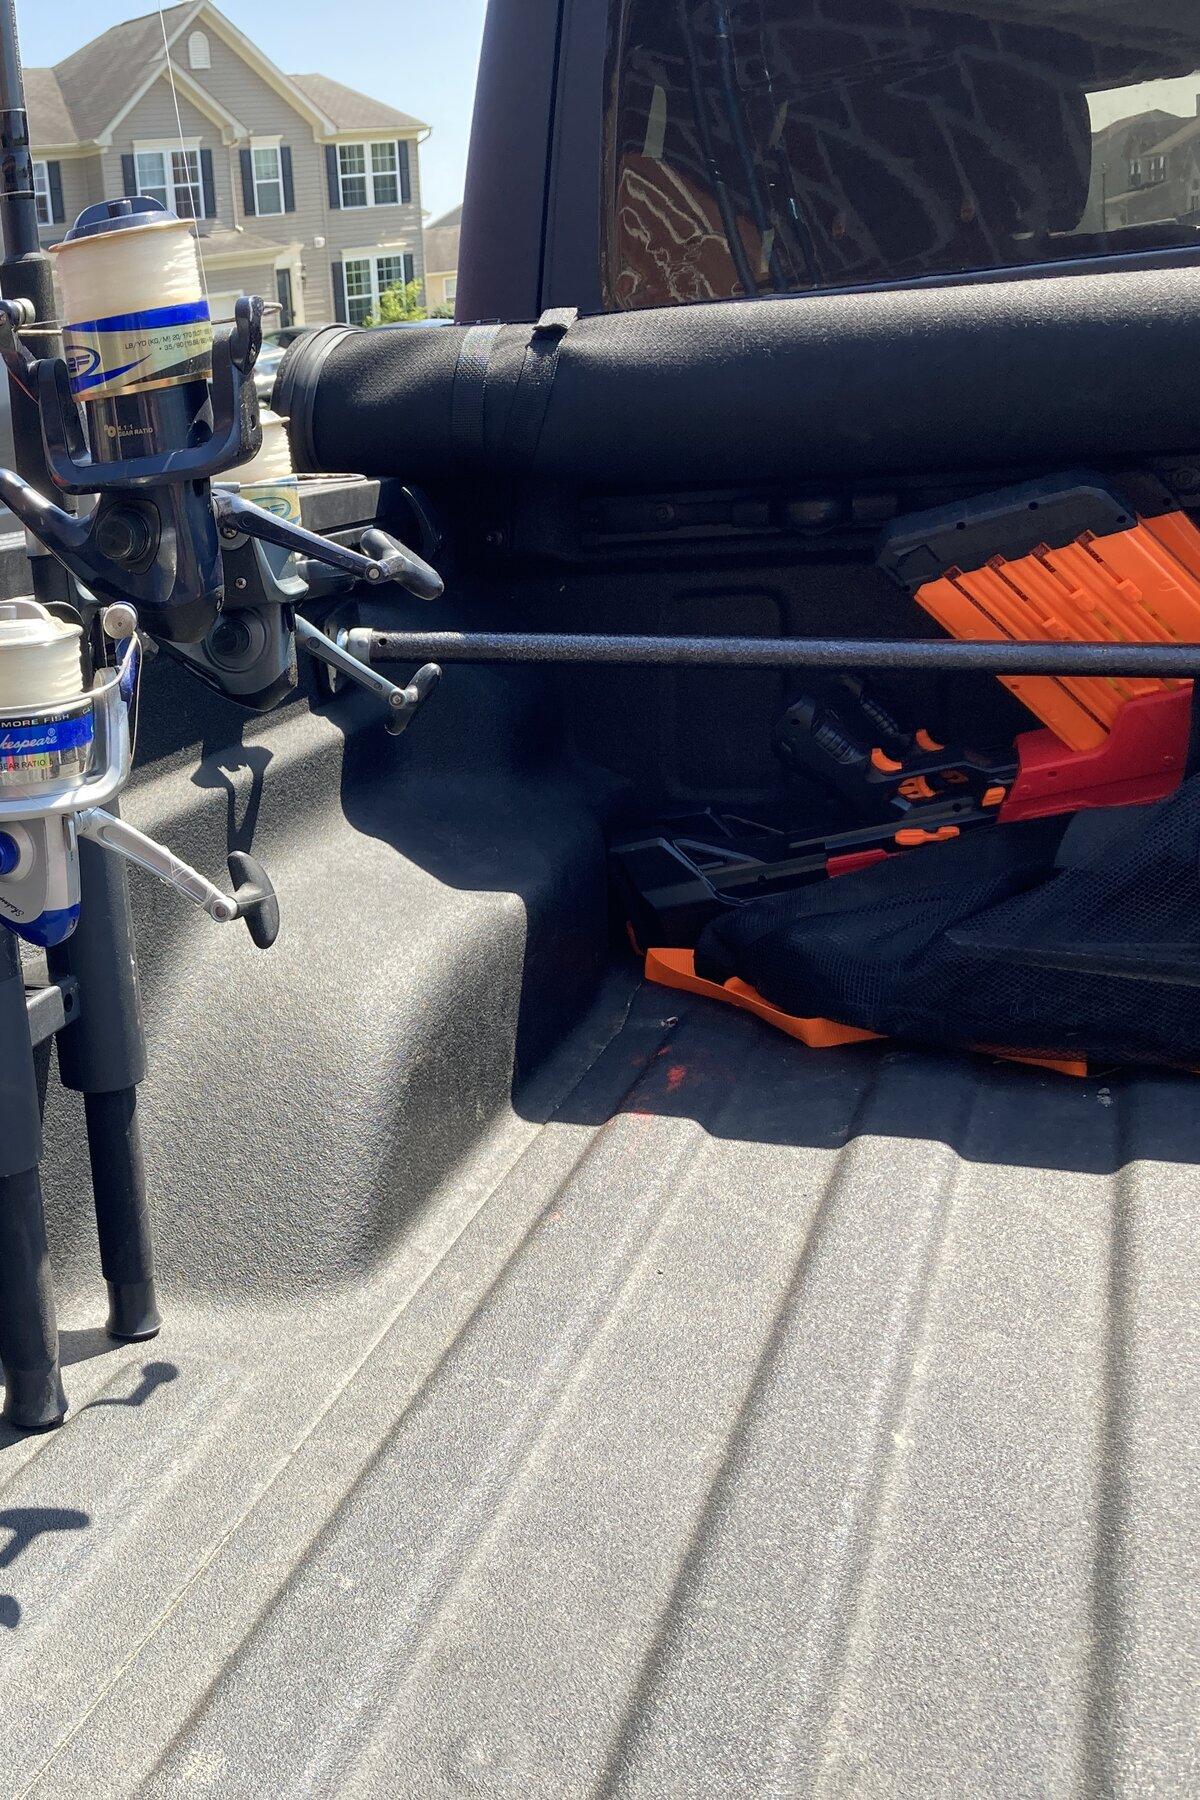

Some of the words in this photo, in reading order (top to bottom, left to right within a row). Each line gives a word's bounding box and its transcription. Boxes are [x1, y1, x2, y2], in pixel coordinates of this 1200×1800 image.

[134, 427, 154, 435] RATIO
[1, 718, 39, 729] MORE
[43, 712, 71, 724] FISH
[21, 758, 46, 769] RATIO
